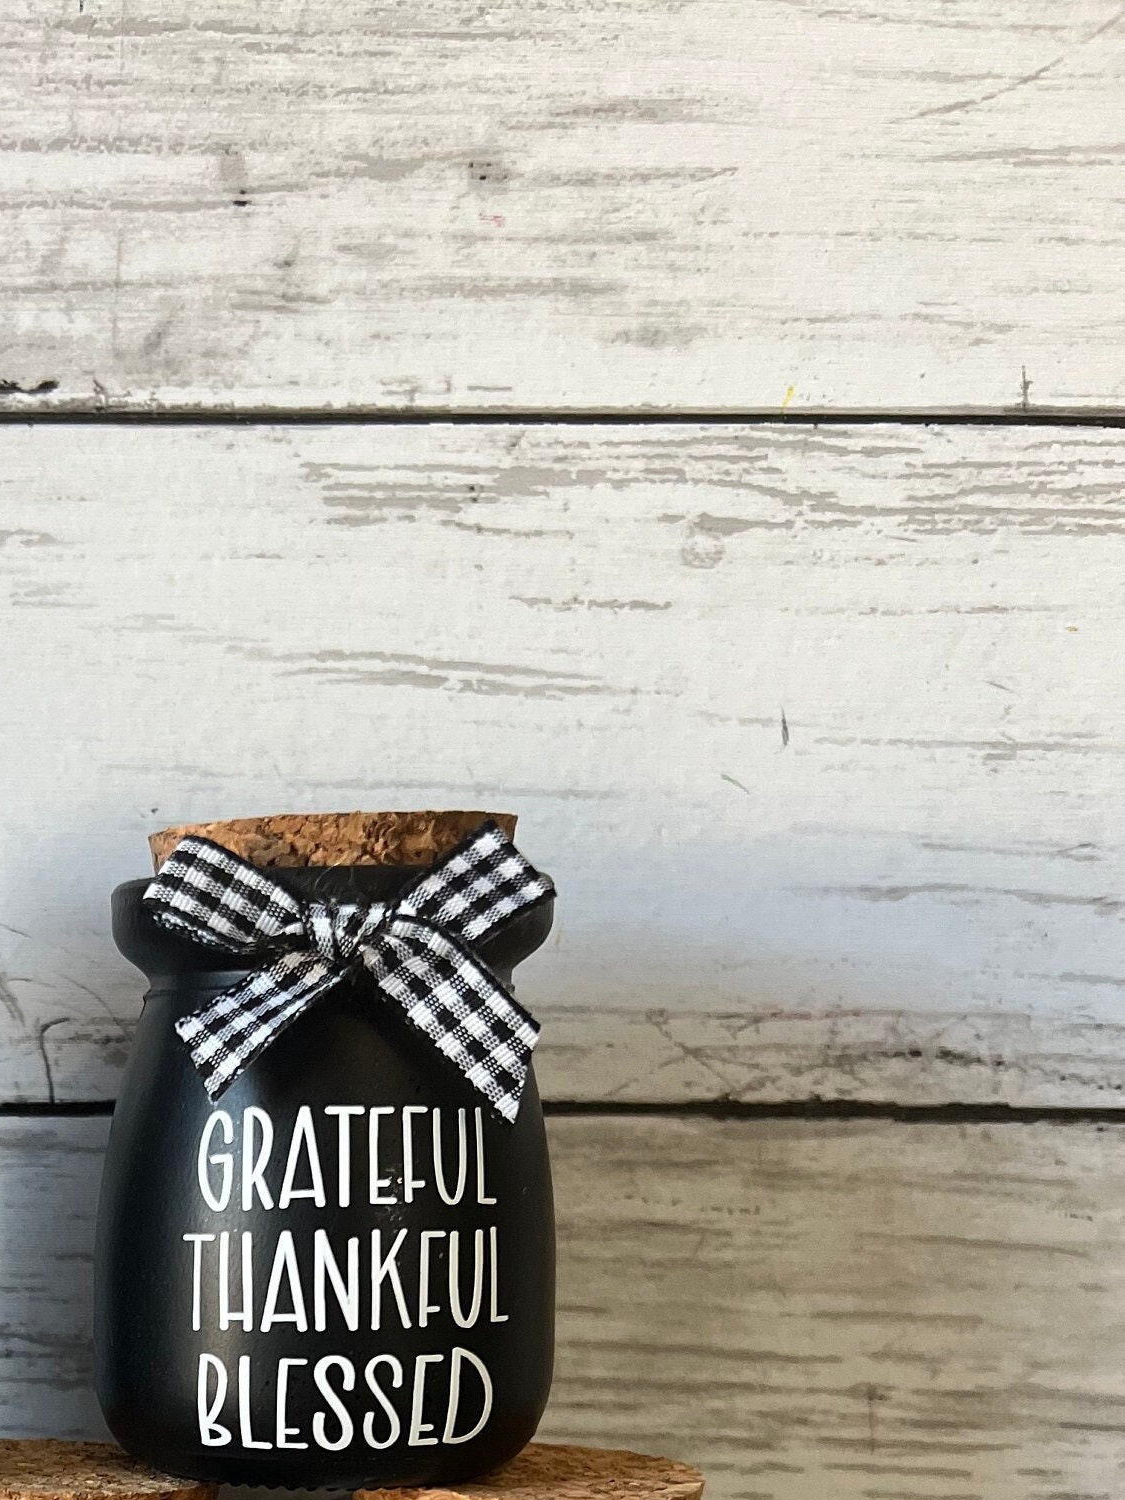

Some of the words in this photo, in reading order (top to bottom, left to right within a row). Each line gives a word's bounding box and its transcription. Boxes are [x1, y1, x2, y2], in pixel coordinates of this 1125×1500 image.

[197, 1105, 498, 1213] GRATEFUL
[182, 1226, 509, 1333] THANKFUL
[196, 1346, 493, 1451] BLESSED
